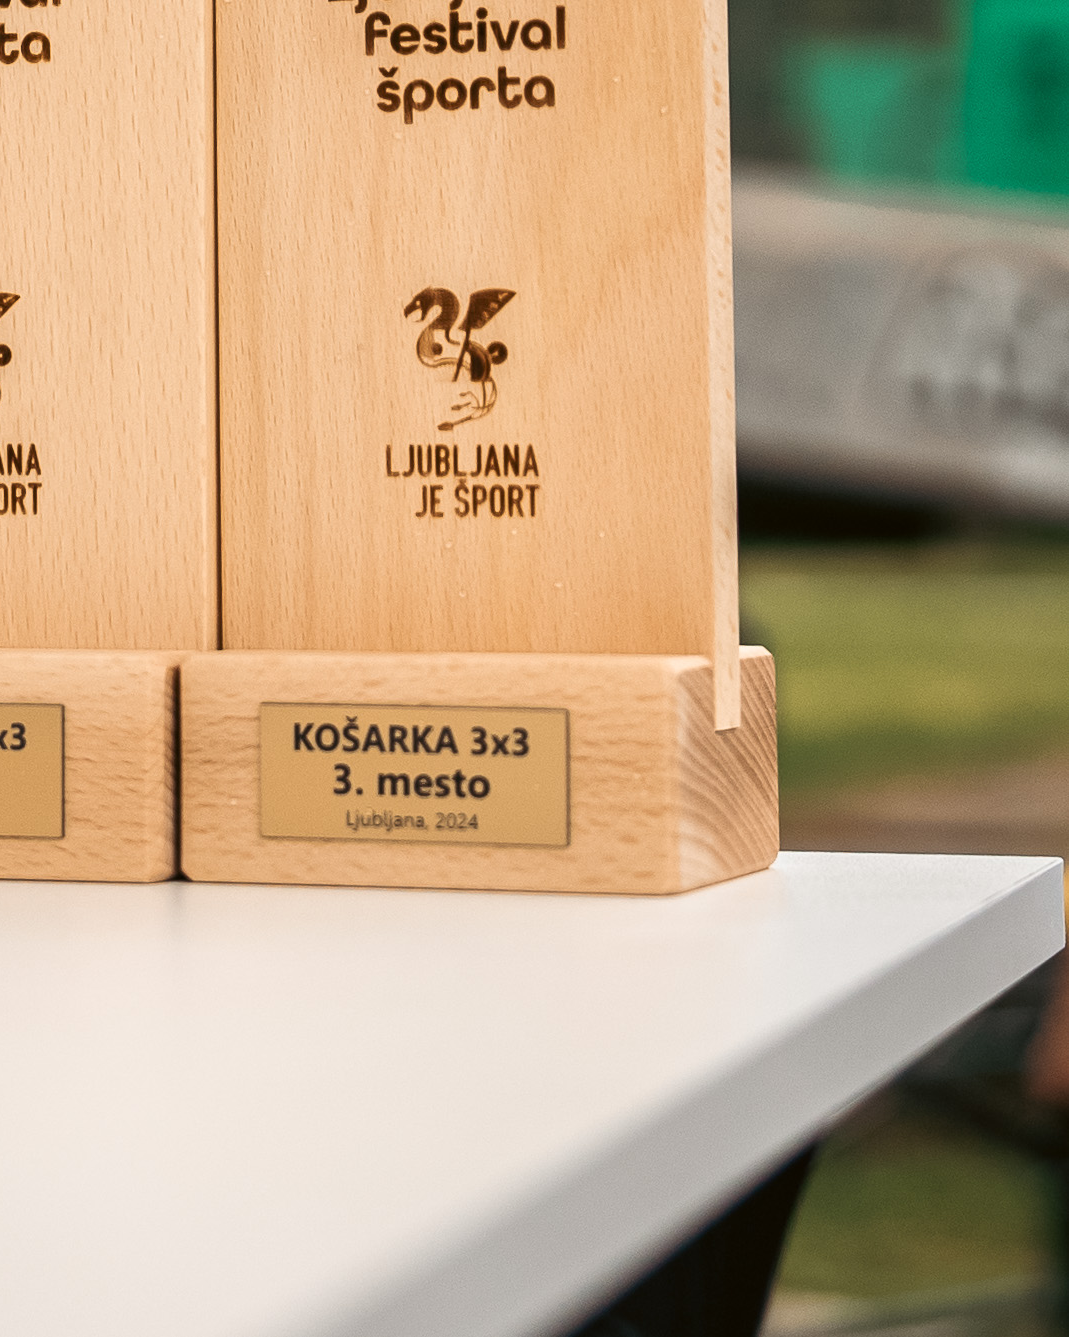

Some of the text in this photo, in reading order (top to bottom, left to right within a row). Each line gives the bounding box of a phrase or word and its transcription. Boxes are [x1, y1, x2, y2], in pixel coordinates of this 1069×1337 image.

[364, 5, 567, 56] festival
[376, 65, 556, 125] športa
[385, 444, 540, 478] LJUBLJANA
[415, 478, 540, 518] JE ŠPORT
[293, 715, 530, 757] KOŠARKA 3x3
[333, 763, 491, 799] 3. mesto
[435, 811, 479, 832] 2024
